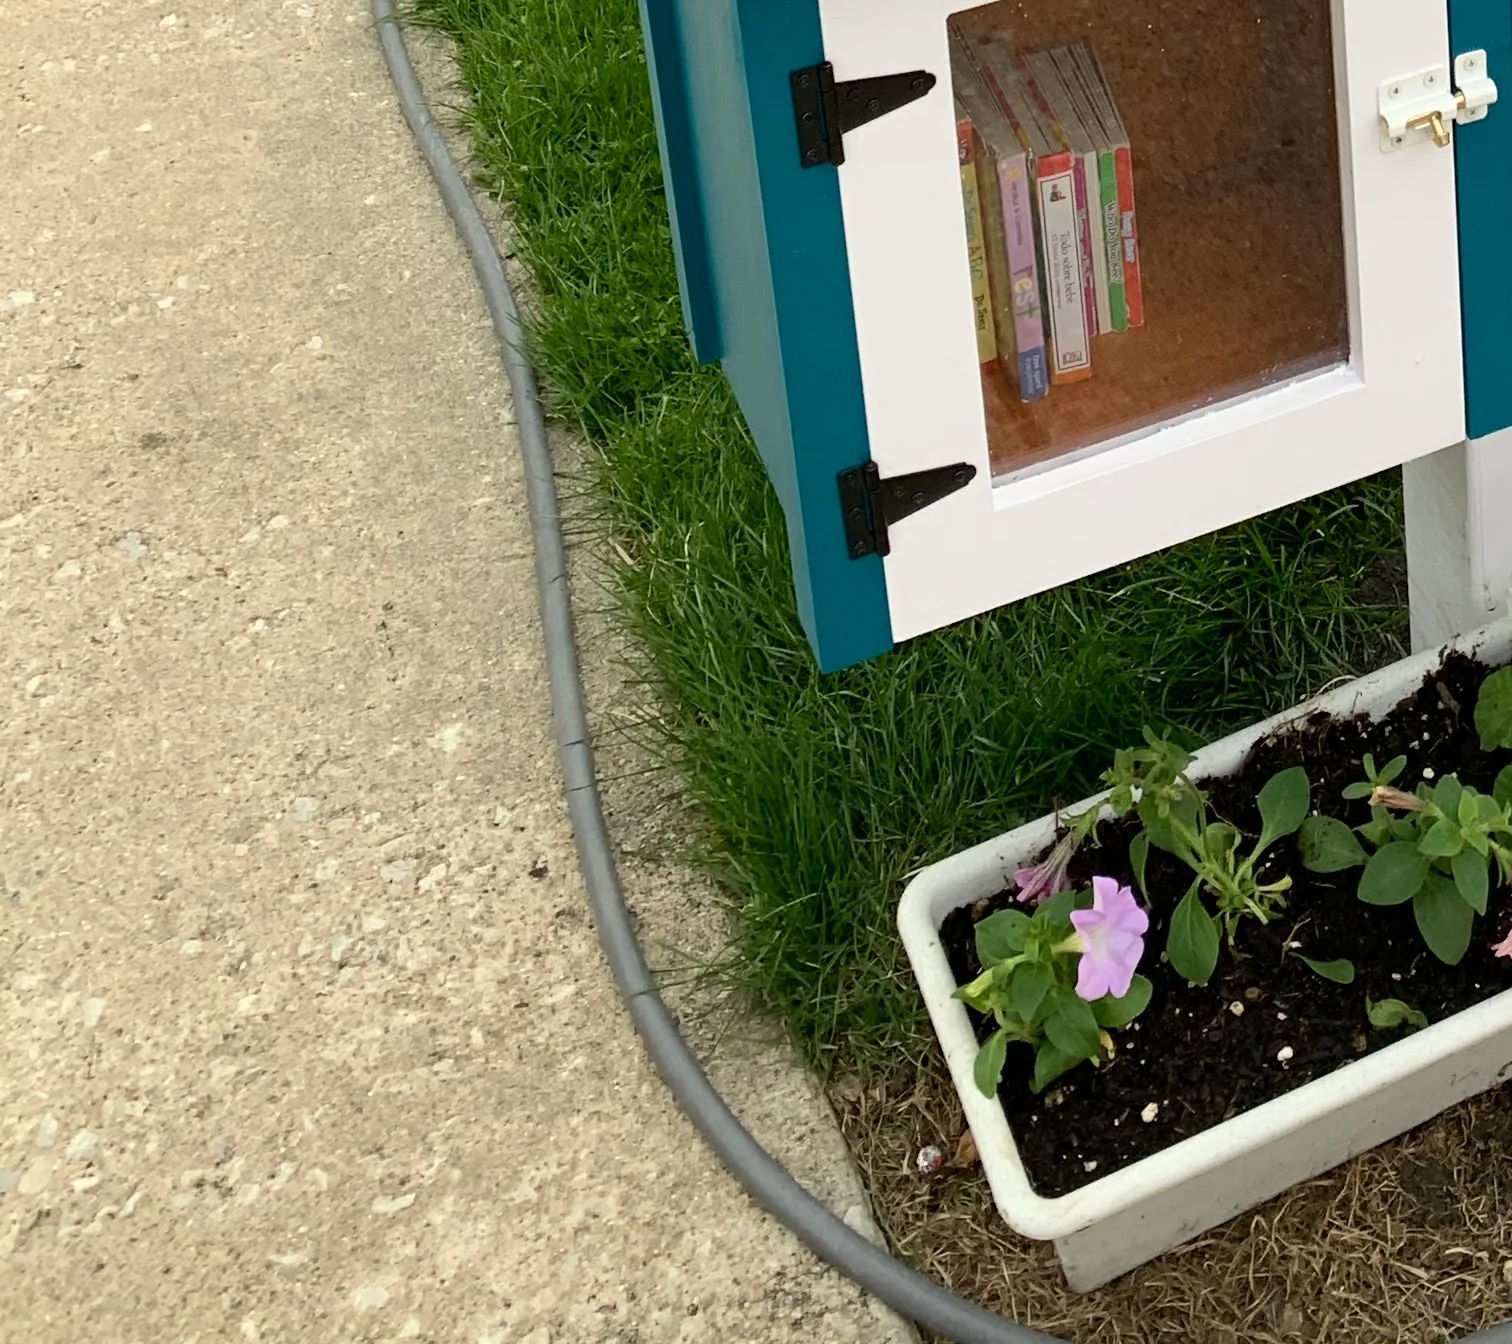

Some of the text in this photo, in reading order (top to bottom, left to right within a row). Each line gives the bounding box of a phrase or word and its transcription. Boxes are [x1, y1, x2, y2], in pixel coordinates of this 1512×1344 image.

[1105, 201, 1116, 226] Who
[1060, 230, 1072, 256] Todo
[1107, 227, 1118, 241] Do
[1109, 241, 1119, 262] You
[1062, 256, 1073, 281] sobre
